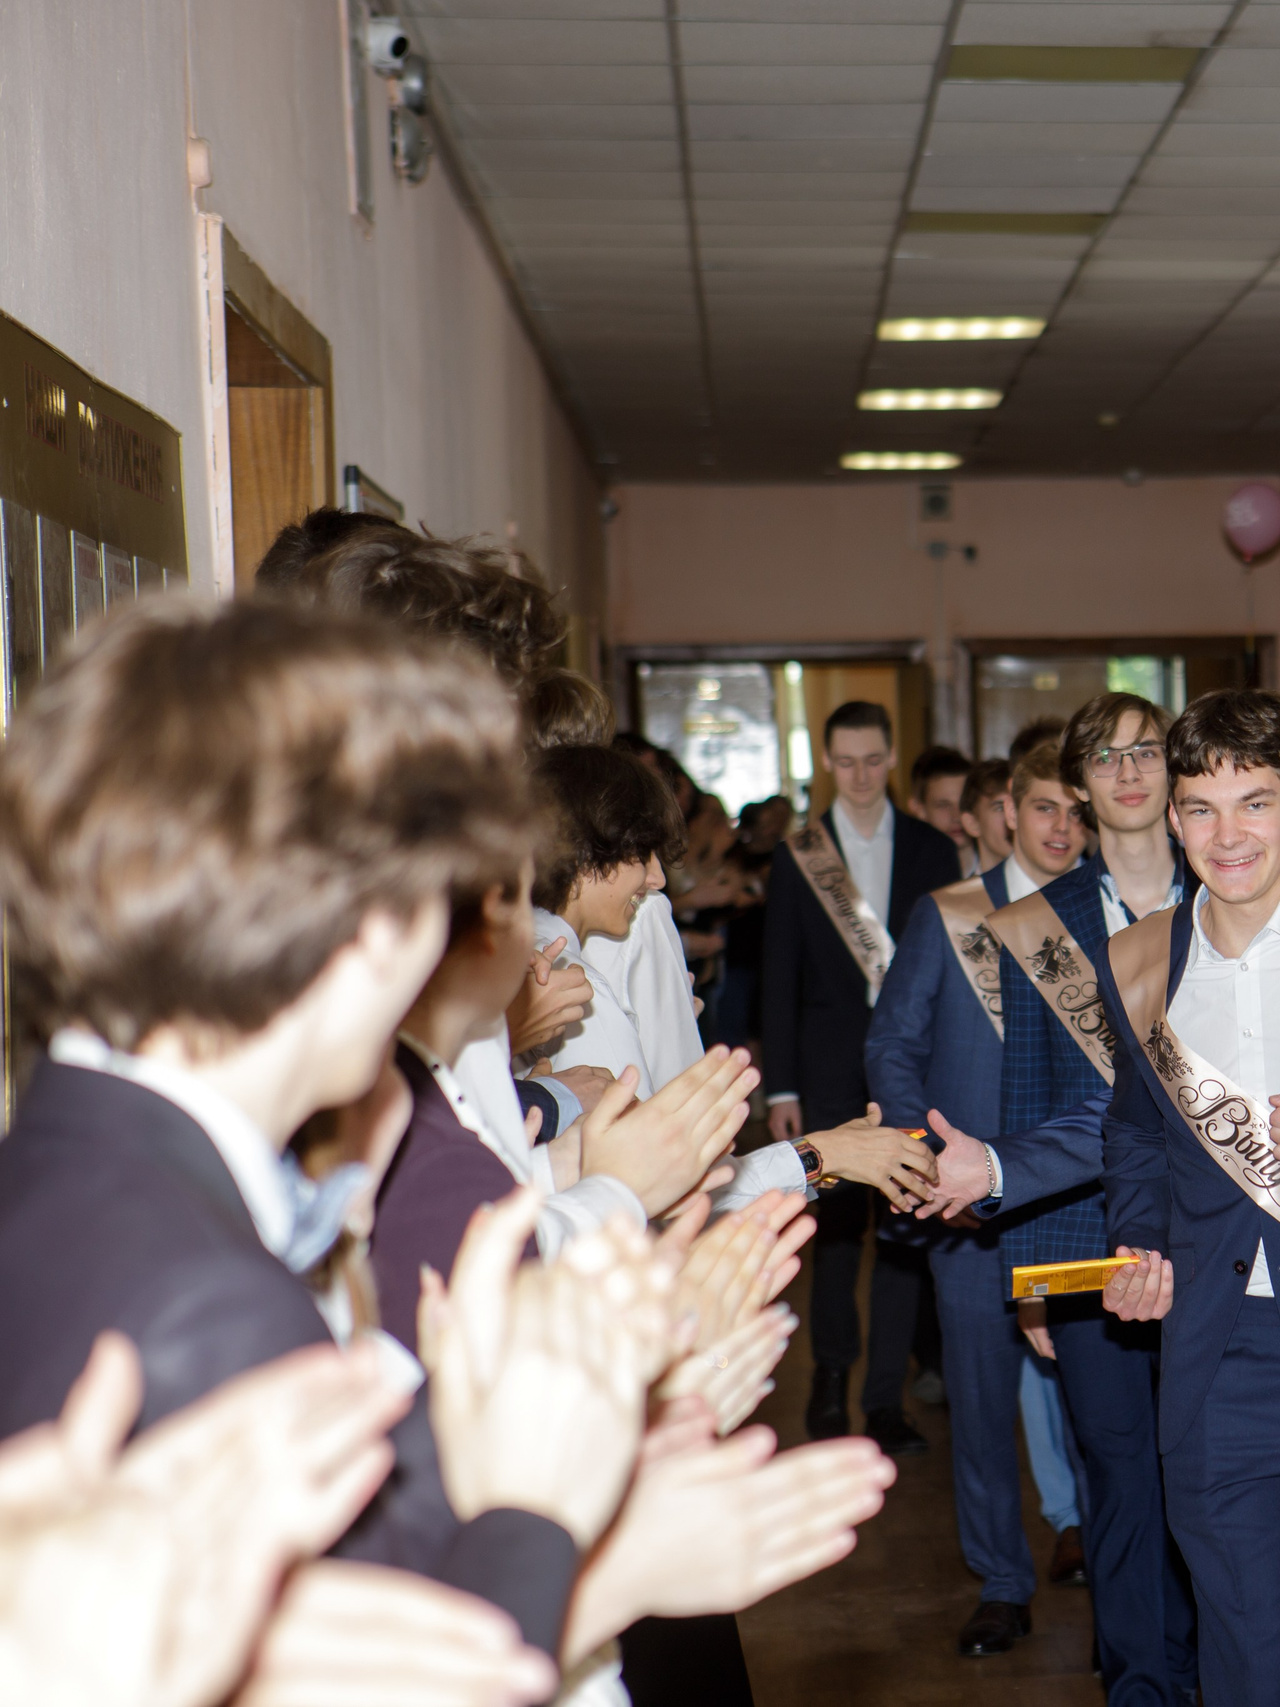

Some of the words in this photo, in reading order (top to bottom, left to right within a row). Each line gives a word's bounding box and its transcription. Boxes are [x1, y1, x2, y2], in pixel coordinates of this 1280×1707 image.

[24, 361, 67, 455] НАШИ
[77, 399, 164, 505] ДОСТИЖЕНИЯ
[807, 858, 878, 964] Выпускник
